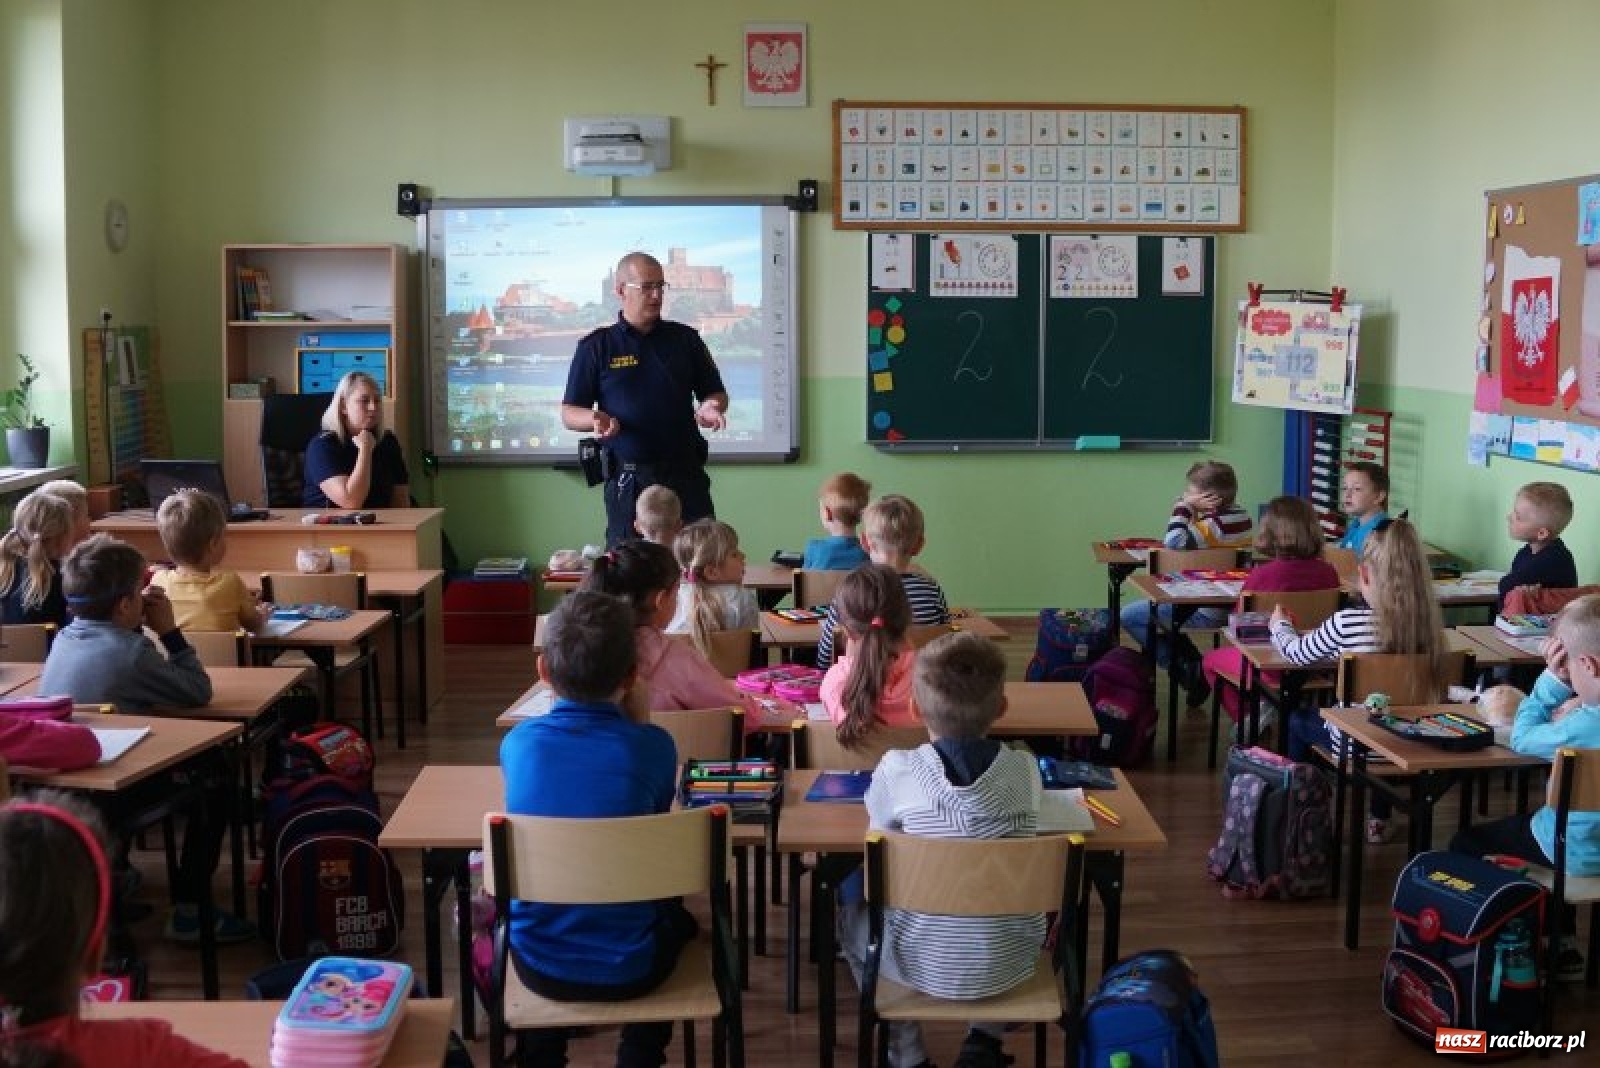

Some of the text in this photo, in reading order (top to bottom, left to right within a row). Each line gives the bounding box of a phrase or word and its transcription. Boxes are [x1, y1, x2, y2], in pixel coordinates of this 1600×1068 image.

[953, 309, 993, 382] 2
[1081, 306, 1122, 390] 2
[335, 895, 369, 915] FCB
[335, 910, 387, 933] BARCA
